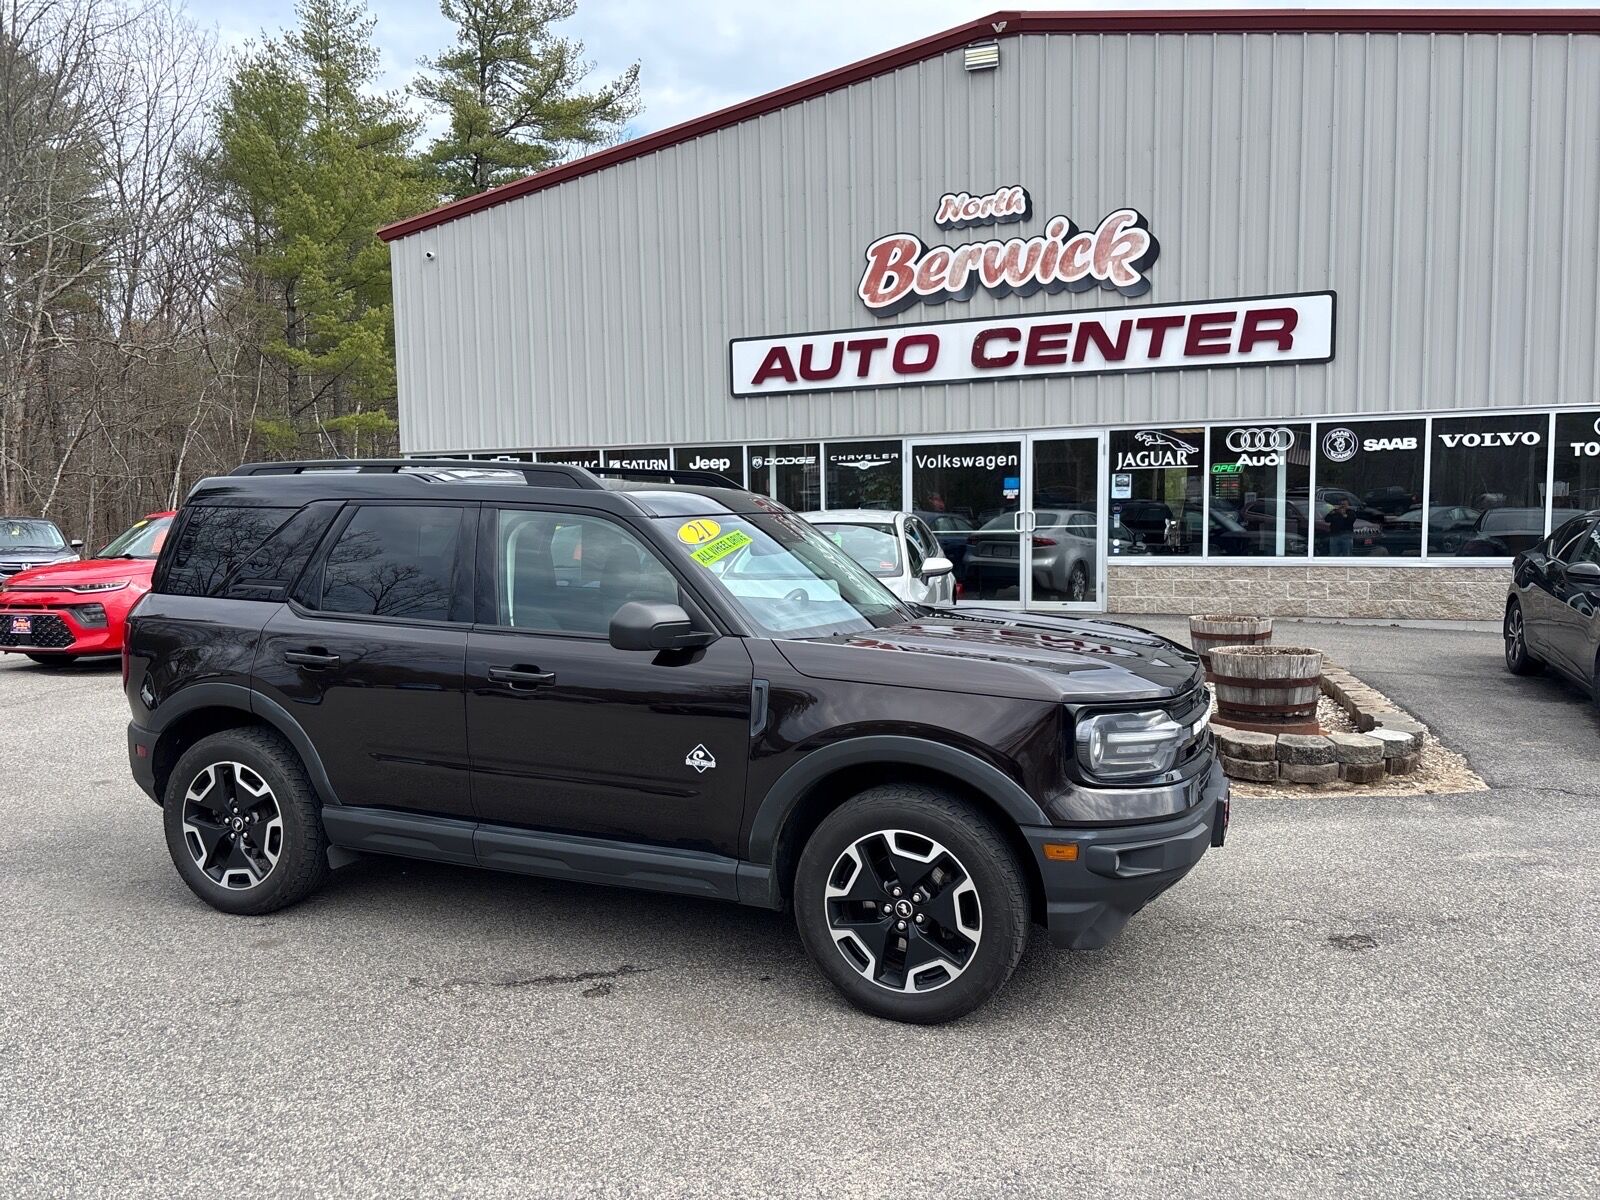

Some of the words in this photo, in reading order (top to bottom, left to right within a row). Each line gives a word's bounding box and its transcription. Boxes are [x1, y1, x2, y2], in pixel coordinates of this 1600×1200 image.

[938, 185, 1028, 224] North
[860, 210, 1150, 306] Berwick
[751, 334, 941, 386] AUTO
[971, 308, 1299, 370] CENTER
[1363, 437, 1418, 452] SAAB
[1438, 432, 1541, 447] VOLVO
[622, 459, 668, 471] SATURN
[688, 455, 731, 472] Jeep
[763, 456, 817, 466] DODGE
[830, 453, 899, 462] CHRYSLER
[915, 454, 1018, 470] Volkswagen
[1116, 450, 1189, 471] JAGUAR
[1236, 453, 1285, 467] Audi
[1212, 464, 1243, 473] OPEN
[687, 521, 712, 542] 21
[697, 550, 713, 562] ALL
[708, 540, 731, 555] WHEEL
